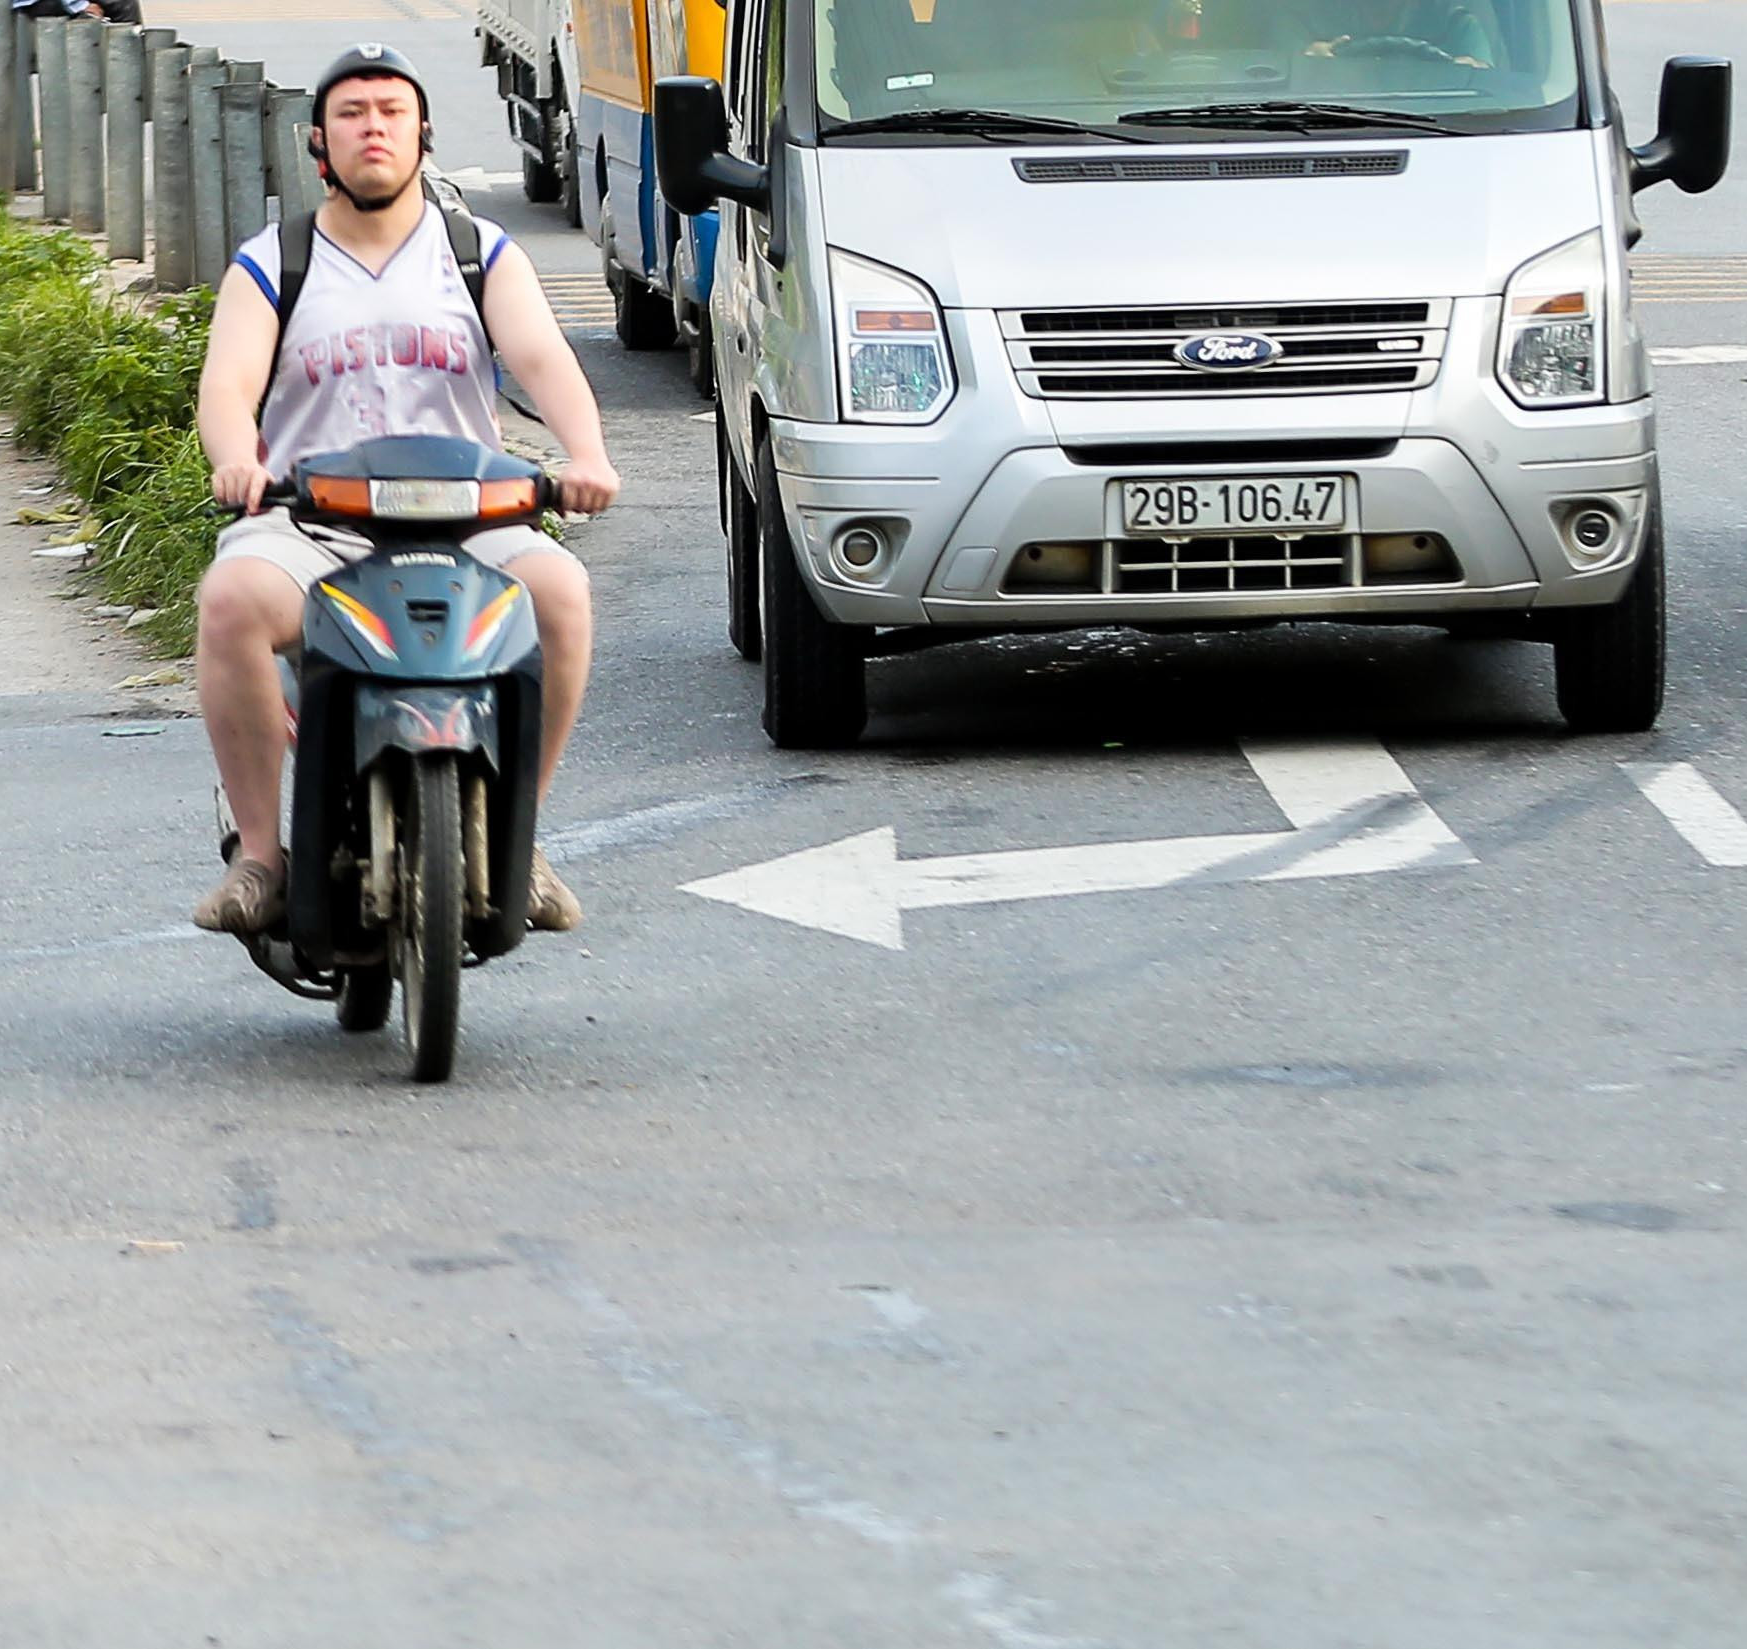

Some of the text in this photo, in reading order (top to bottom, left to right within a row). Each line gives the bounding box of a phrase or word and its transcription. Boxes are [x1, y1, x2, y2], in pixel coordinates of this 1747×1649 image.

[299, 322, 468, 386] PISTONS
[1198, 335, 1258, 361] Ford
[1129, 481, 1337, 527] 29B-106.47
